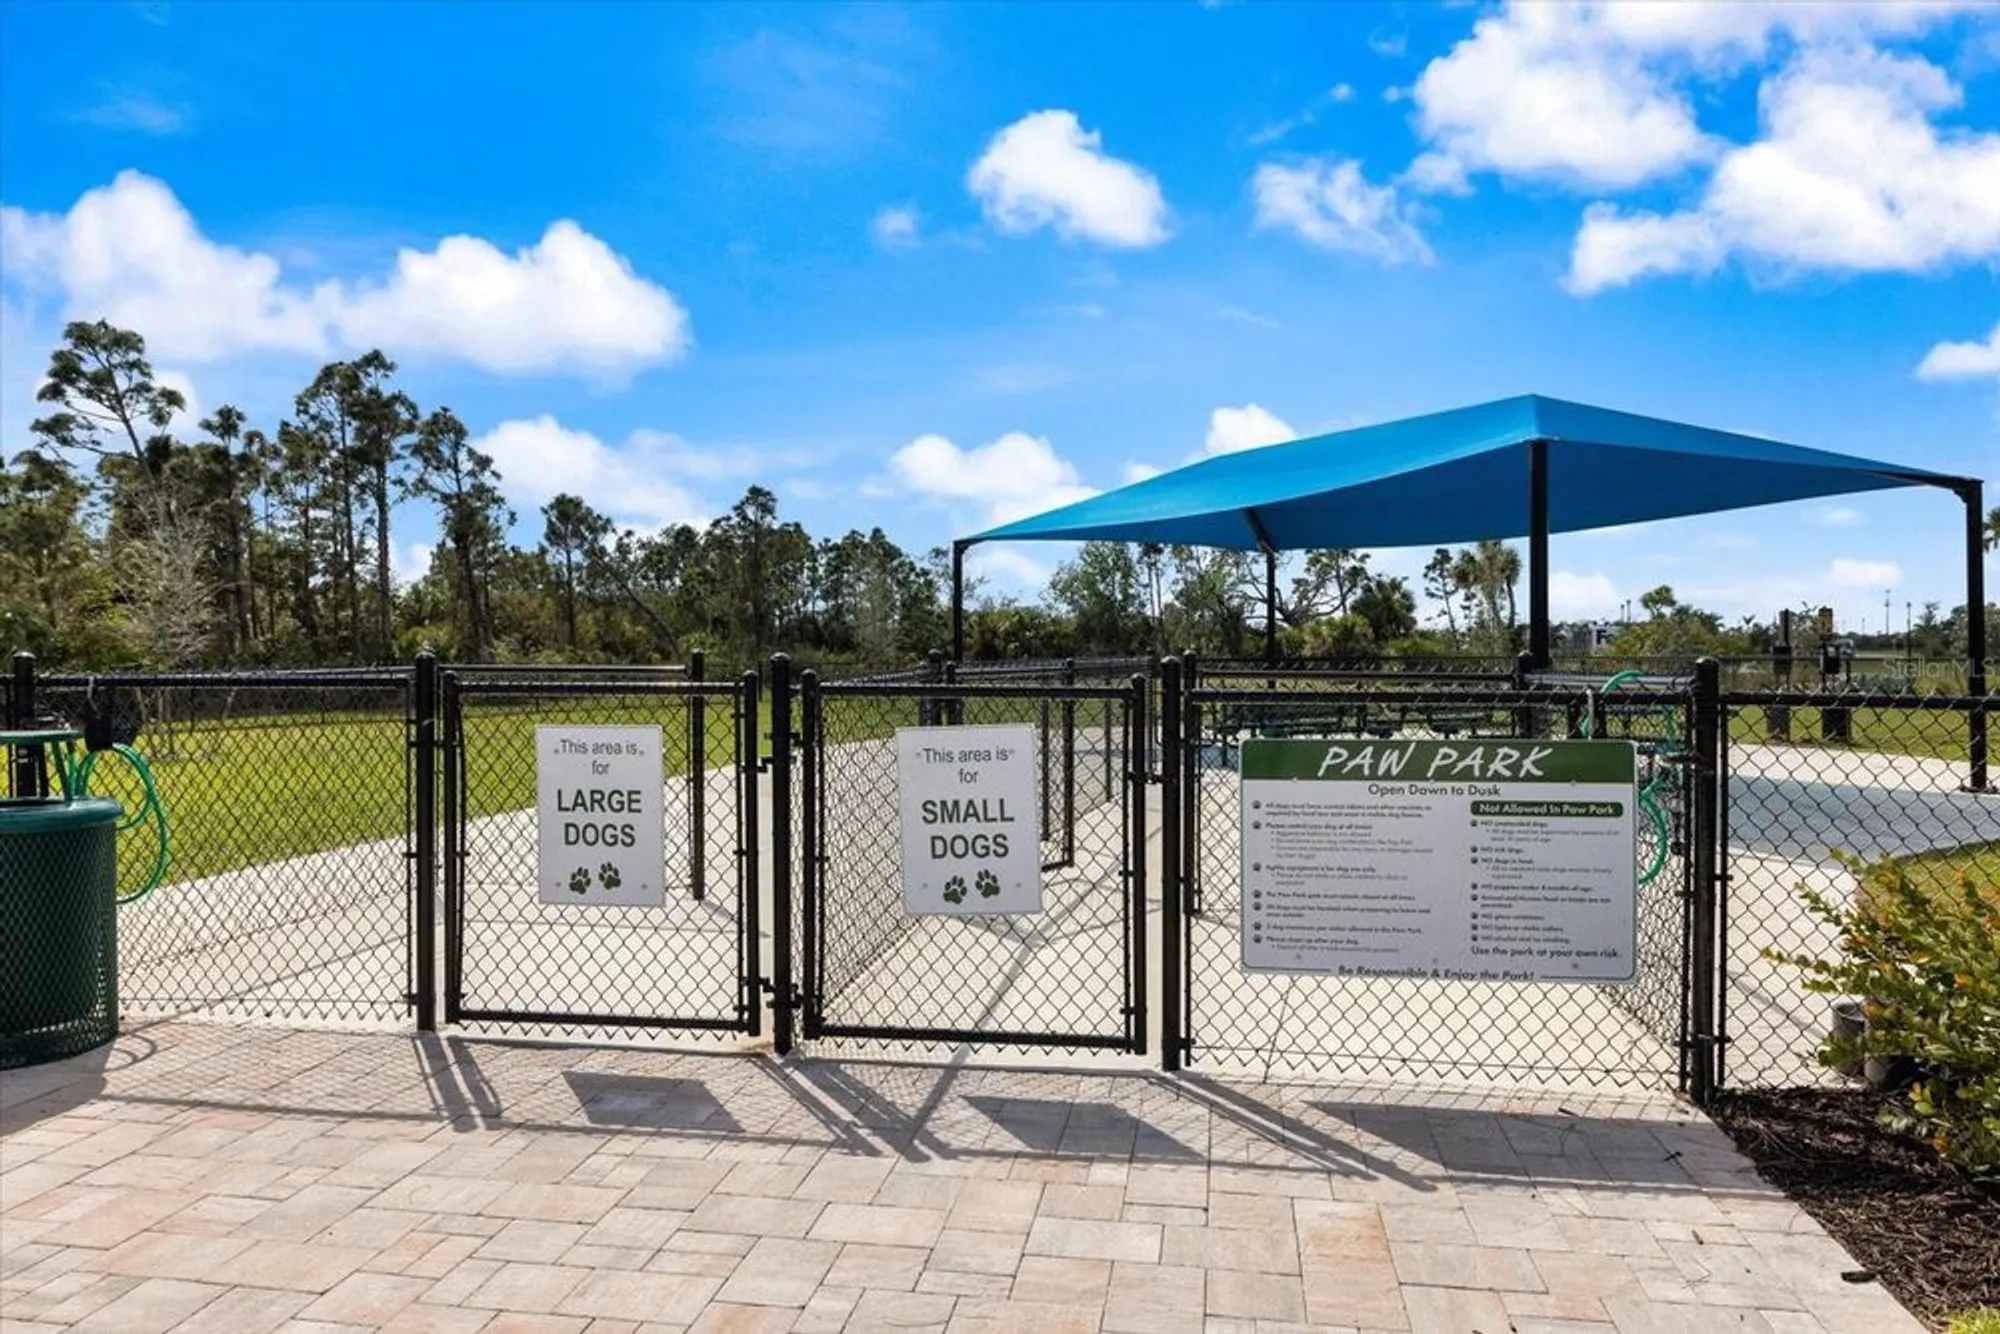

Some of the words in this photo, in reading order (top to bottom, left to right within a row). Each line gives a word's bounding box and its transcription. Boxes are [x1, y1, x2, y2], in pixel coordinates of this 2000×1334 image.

[560, 739, 588, 754] This
[592, 742, 622, 755] area
[626, 740, 638, 755] is
[923, 748, 954, 763] This
[958, 749, 992, 762] area
[996, 746, 1009, 761] is
[592, 760, 610, 775] for
[1317, 742, 1416, 777] PAW
[1426, 746, 1553, 778] PARK
[959, 768, 978, 784] for
[1368, 783, 1404, 797] Open
[1408, 783, 1447, 795] Dawn
[1451, 784, 1463, 796] to
[1467, 784, 1501, 796] Dusk
[557, 789, 642, 813] LARGE
[921, 798, 1015, 824] SMALL
[1480, 804, 1499, 815] Not
[1501, 804, 1547, 816] Allowed
[1563, 805, 1588, 816] Paw
[1589, 805, 1615, 818] Park
[564, 823, 636, 847] DOGS
[931, 834, 1009, 859] DOGS
[1472, 946, 1489, 955] Use
[1492, 946, 1508, 955] the
[1510, 947, 1533, 957] park
[1550, 950, 1573, 959] your
[1575, 950, 1598, 958] own
[1339, 965, 1353, 975] Be
[1357, 966, 1428, 978] Responsible
[1431, 969, 1439, 978] &
[1444, 969, 1476, 980] Enjoy
[1480, 969, 1499, 979] the
[1503, 970, 1534, 981] Park!
